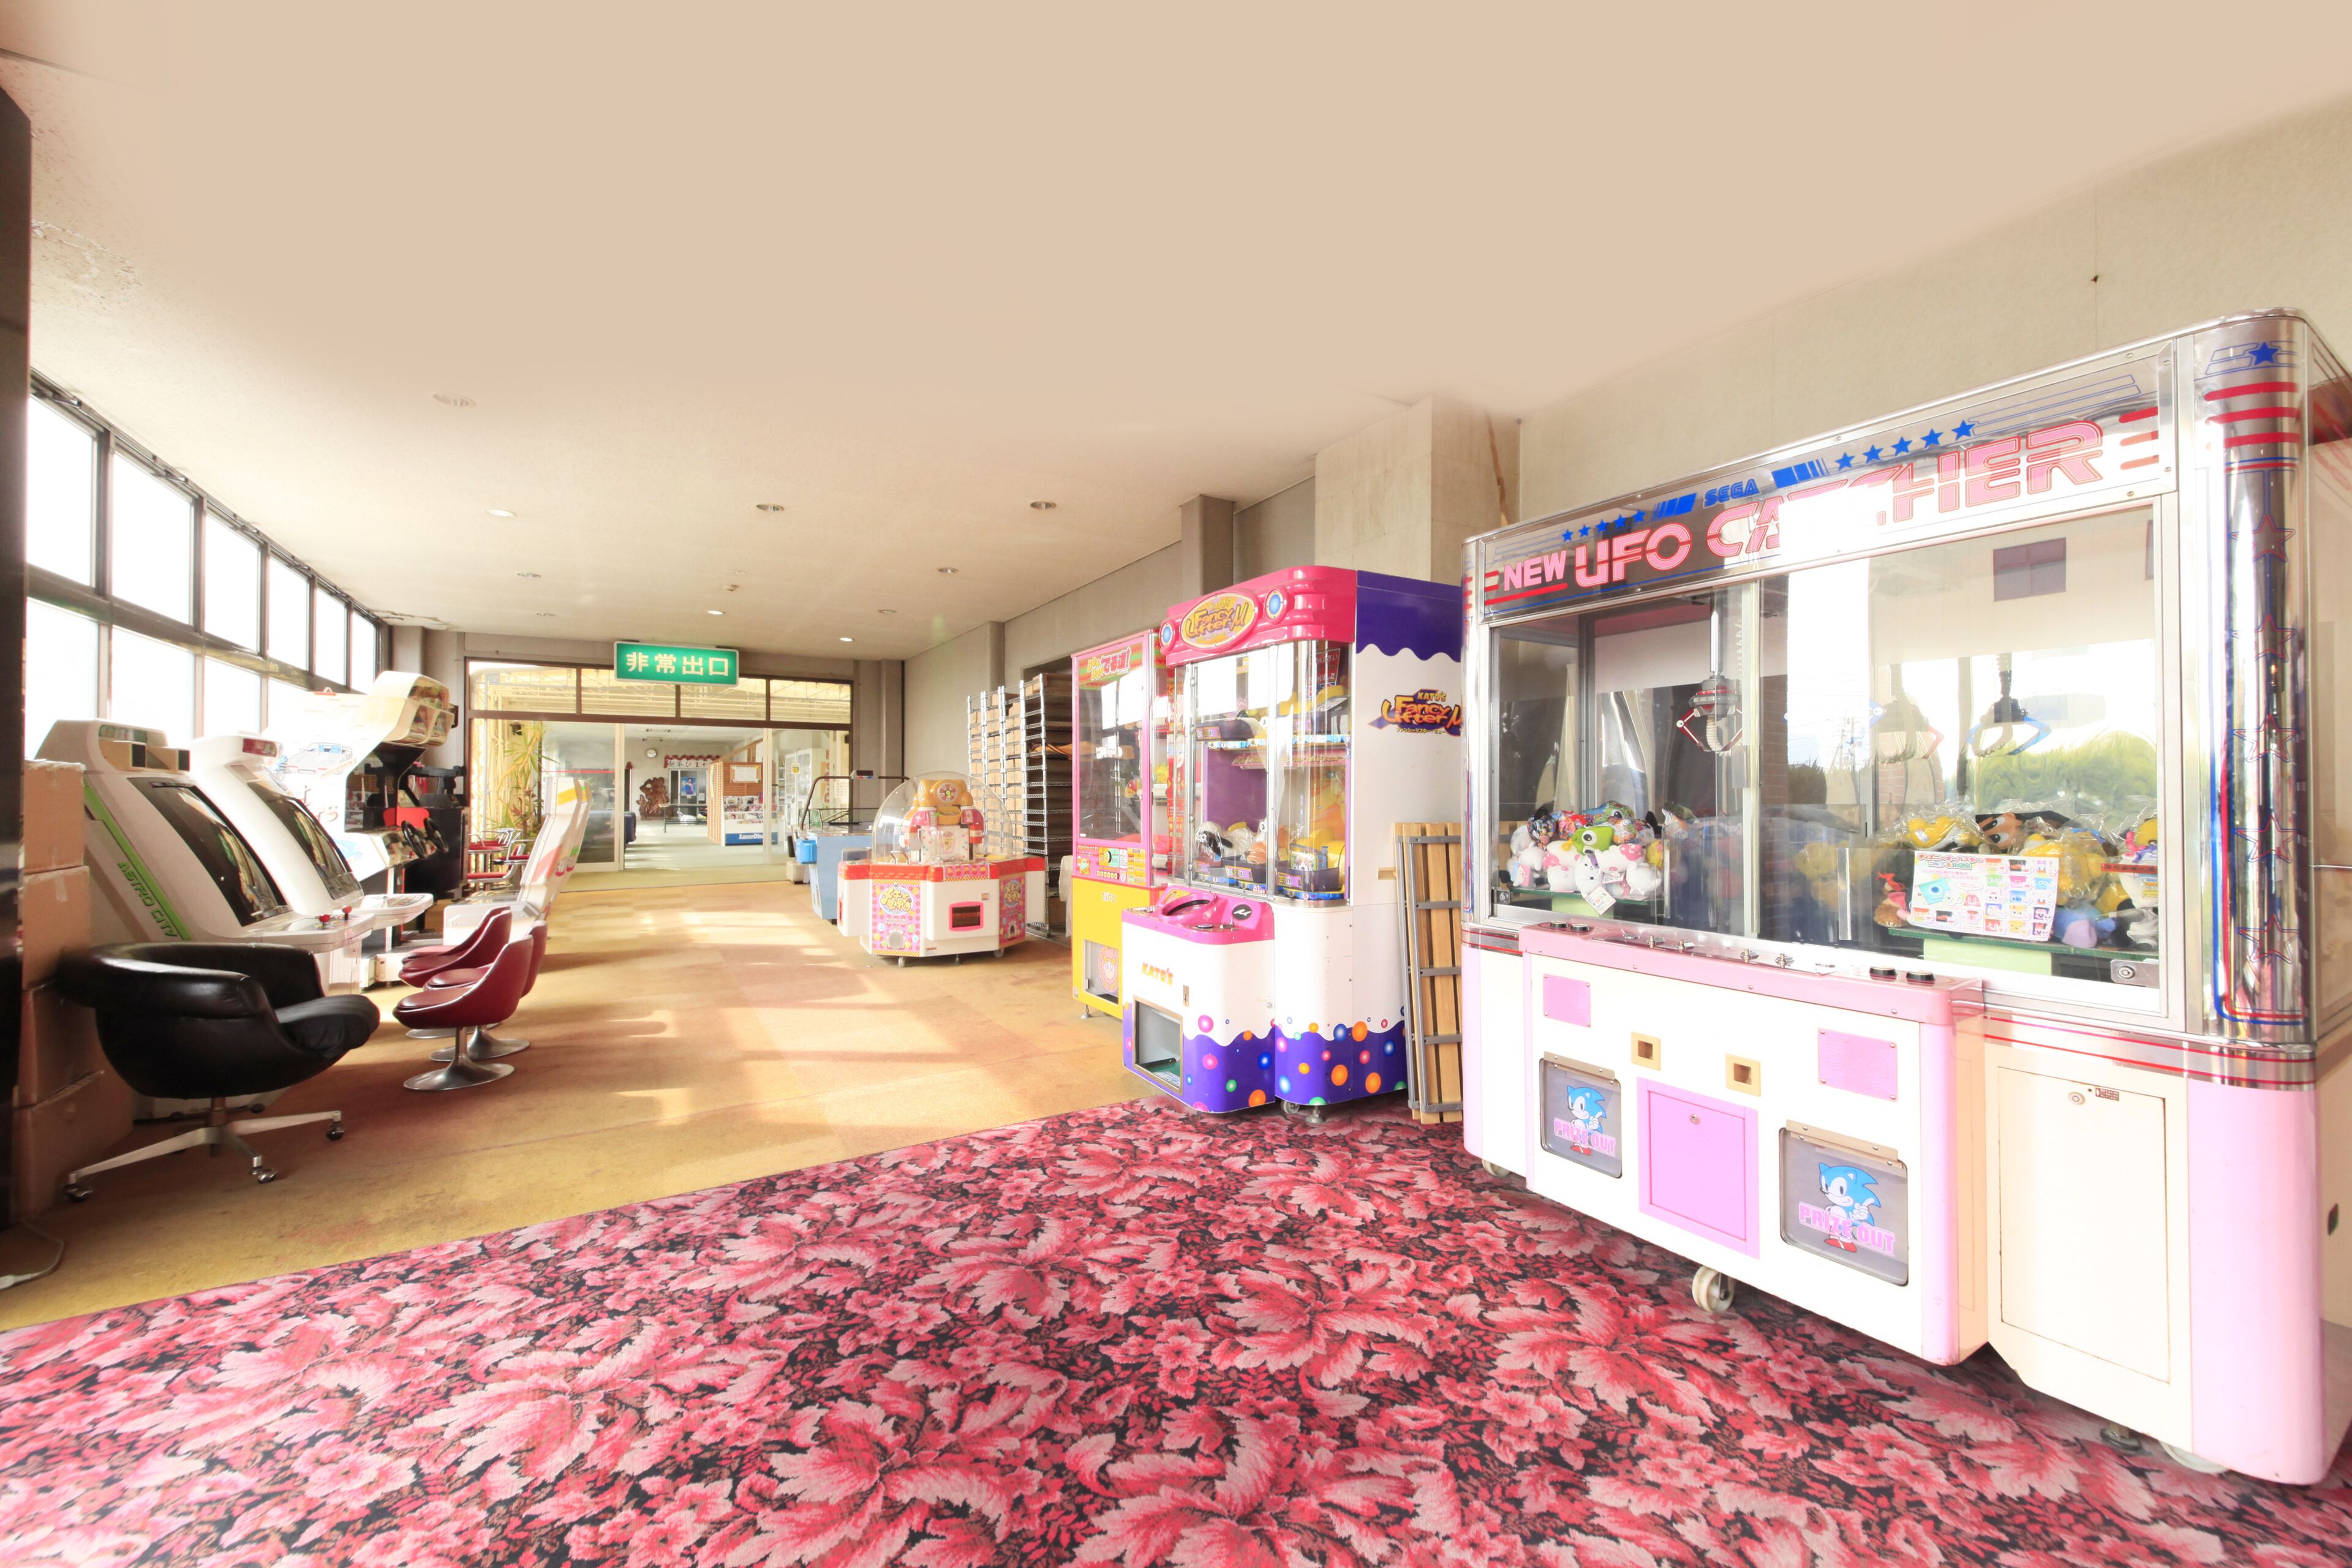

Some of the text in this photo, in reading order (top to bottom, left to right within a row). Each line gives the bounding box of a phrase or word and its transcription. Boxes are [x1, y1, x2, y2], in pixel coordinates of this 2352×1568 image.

[1504, 420, 2103, 592] NEW UFO CAHER
[1703, 478, 1760, 508] SEGA
[1194, 608, 1235, 624] Fancy
[626, 651, 729, 677] 非常出口
[1394, 695, 1452, 715] Fancy
[1418, 691, 1447, 702] KATO'S
[1381, 699, 1448, 725] Lifter
[117, 862, 178, 937] ASTRO CITY
[1142, 962, 1174, 986] KATO'S
[1554, 1119, 1616, 1155] PRIZE OUT
[1798, 1203, 1896, 1254] PRIZE OUT
